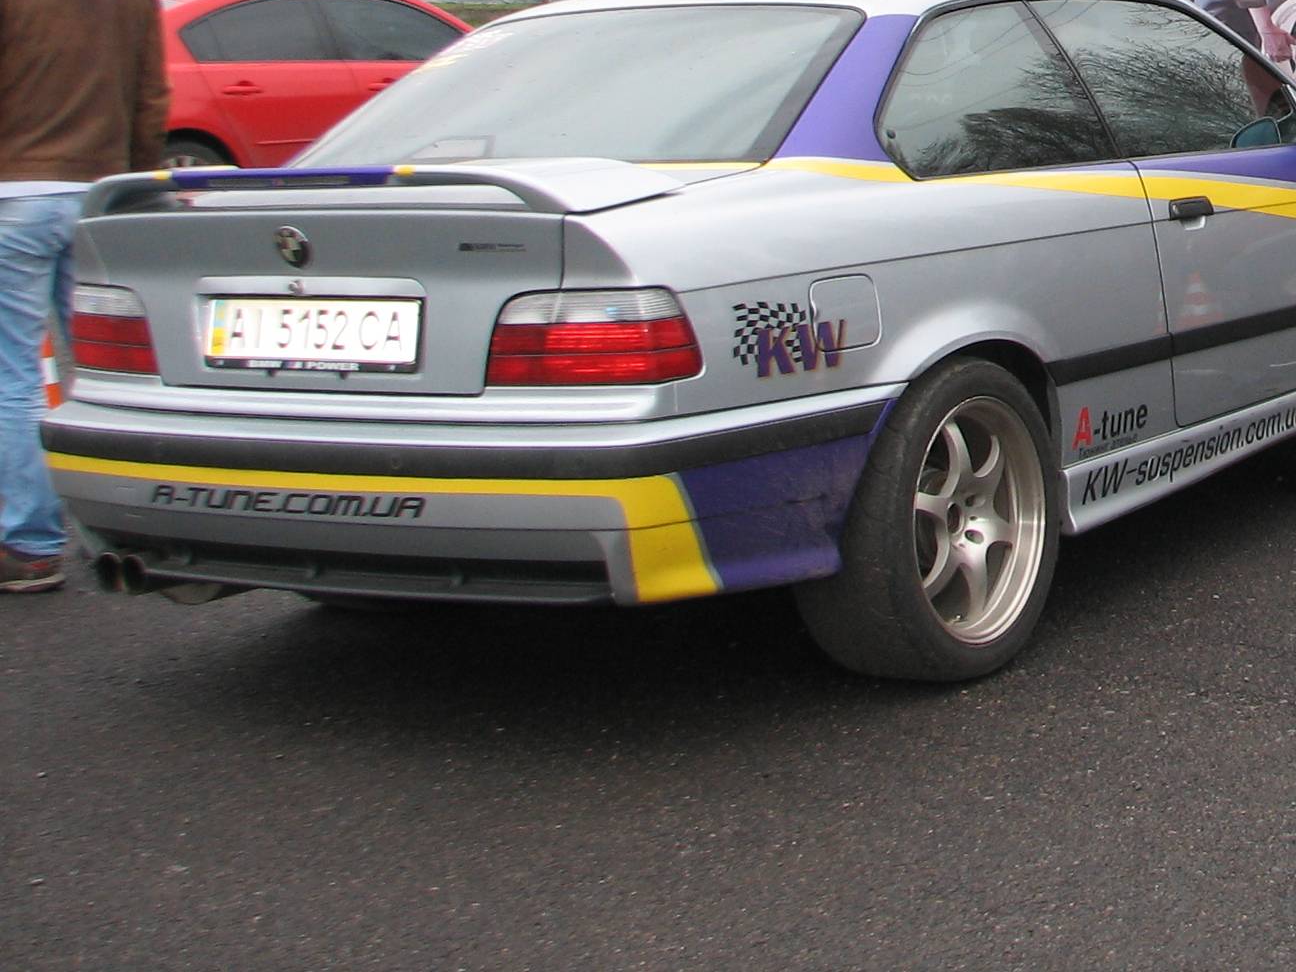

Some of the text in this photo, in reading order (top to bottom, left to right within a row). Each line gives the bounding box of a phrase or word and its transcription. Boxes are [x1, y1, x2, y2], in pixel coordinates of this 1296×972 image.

[276, 308, 346, 351] 5152
[358, 310, 403, 352] CA
[757, 319, 848, 378] KW
[1072, 404, 1148, 450] A-tune
